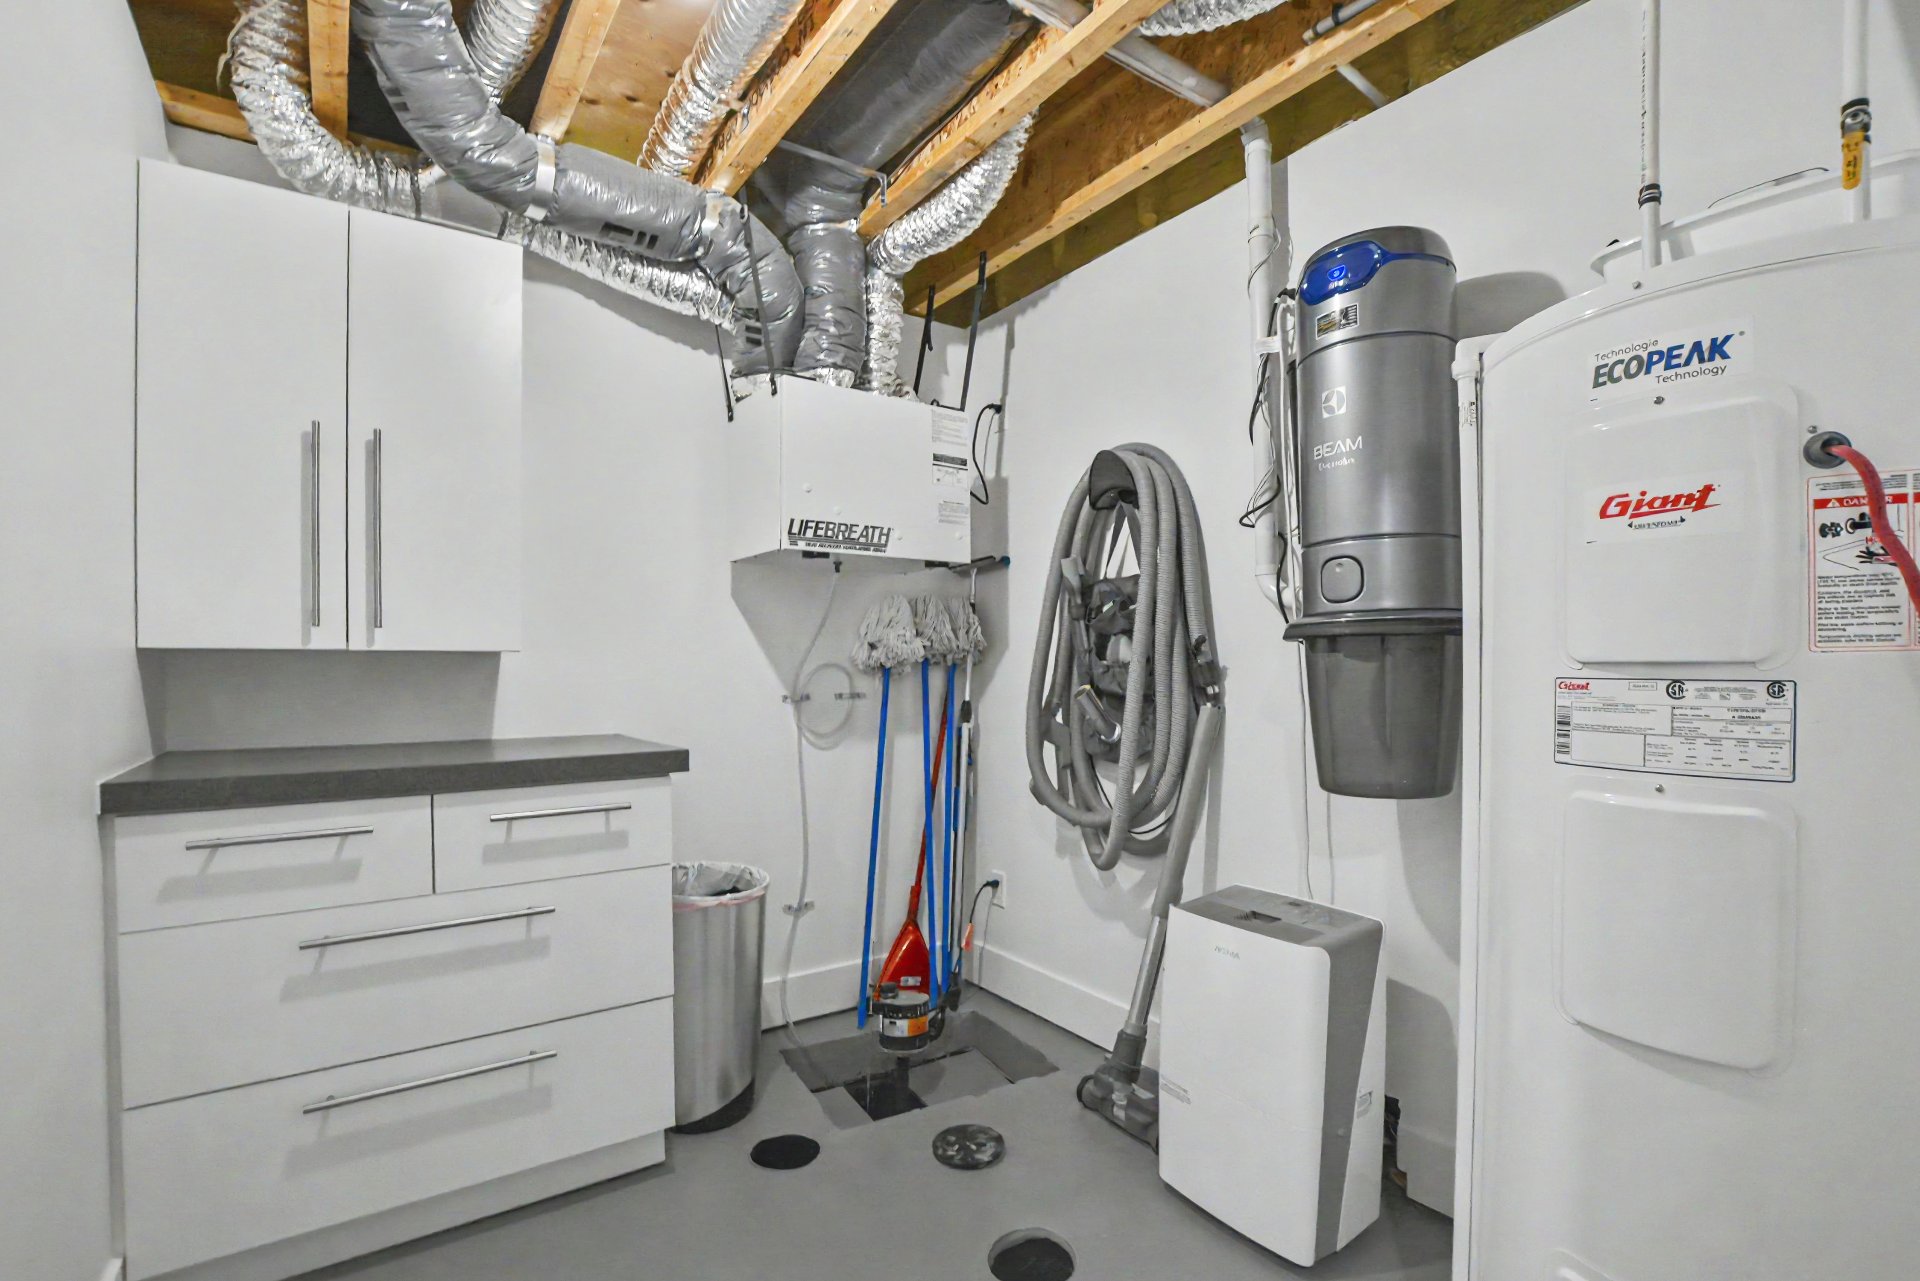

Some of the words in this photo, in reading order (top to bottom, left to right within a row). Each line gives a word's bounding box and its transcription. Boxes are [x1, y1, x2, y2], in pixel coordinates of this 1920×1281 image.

[1592, 333, 1735, 389] ECOPEAK
[1595, 339, 1659, 361] Technologie
[1655, 365, 1727, 384] Technology
[1313, 435, 1363, 460] BEAM
[1599, 484, 1718, 519] Giant
[1843, 494, 1893, 507] DANR
[788, 518, 891, 544] LIFEBREATH
